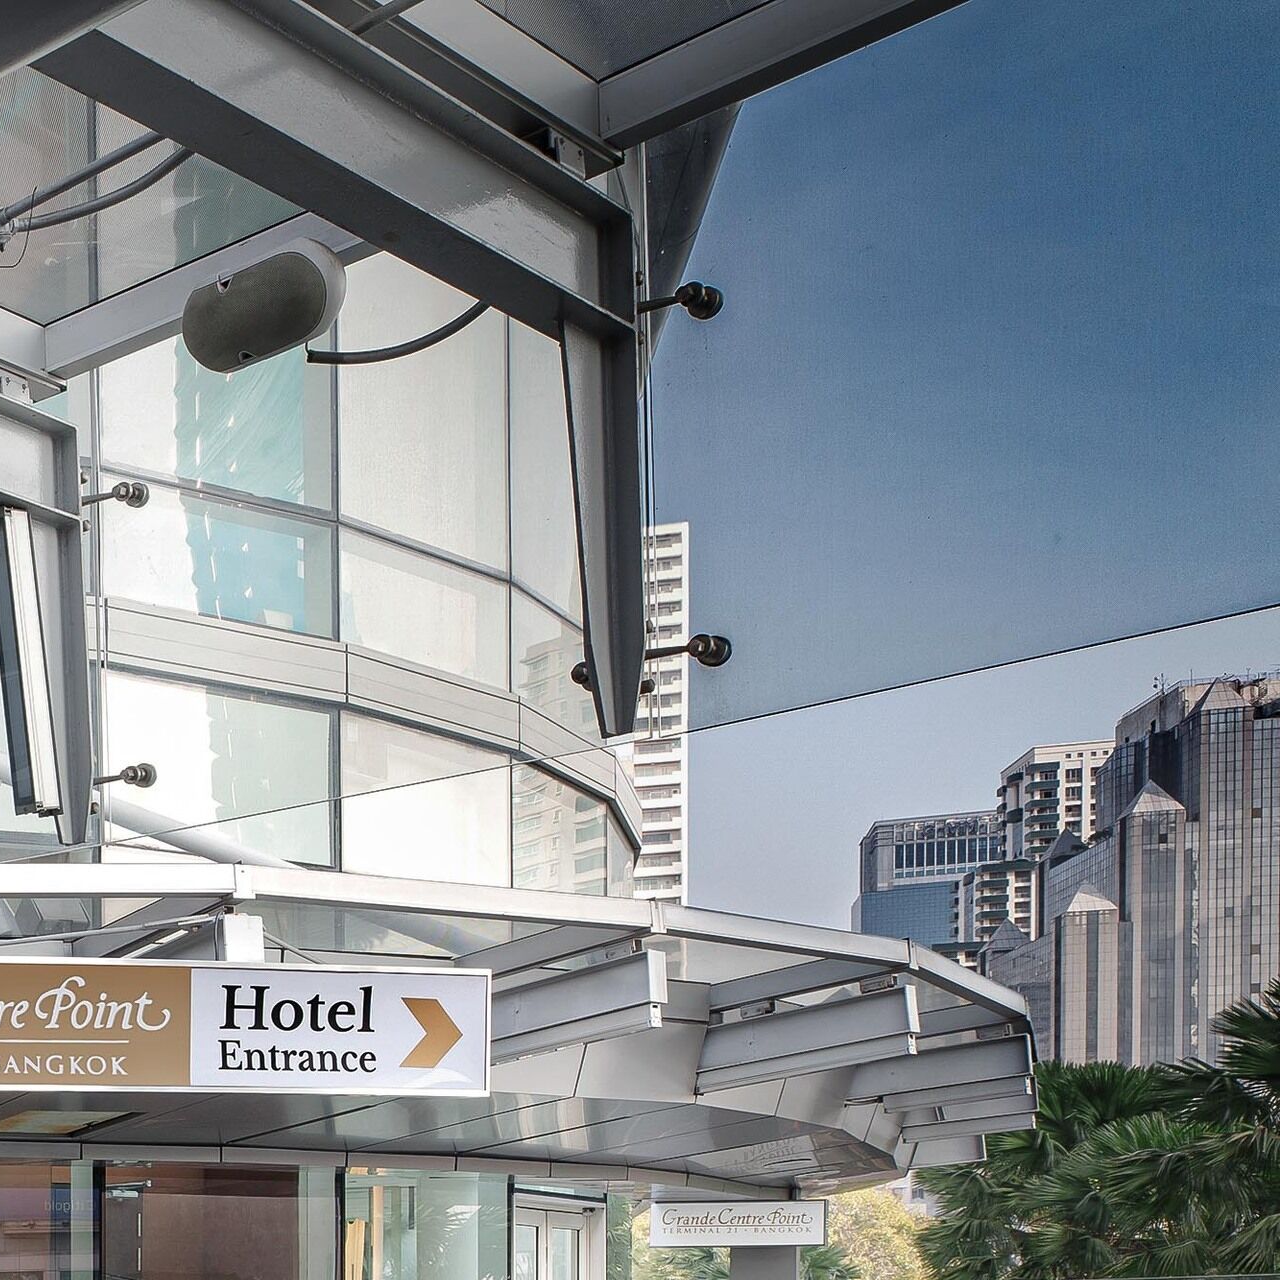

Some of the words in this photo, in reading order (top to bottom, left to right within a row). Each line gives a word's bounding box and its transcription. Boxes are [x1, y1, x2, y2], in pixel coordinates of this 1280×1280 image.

[35, 975, 171, 1031] Point
[219, 984, 375, 1033] Hotel
[218, 1039, 377, 1073] Entrance
[662, 1208, 715, 1225] Grande
[718, 1208, 765, 1225] Centre
[766, 1207, 813, 1225] Point
